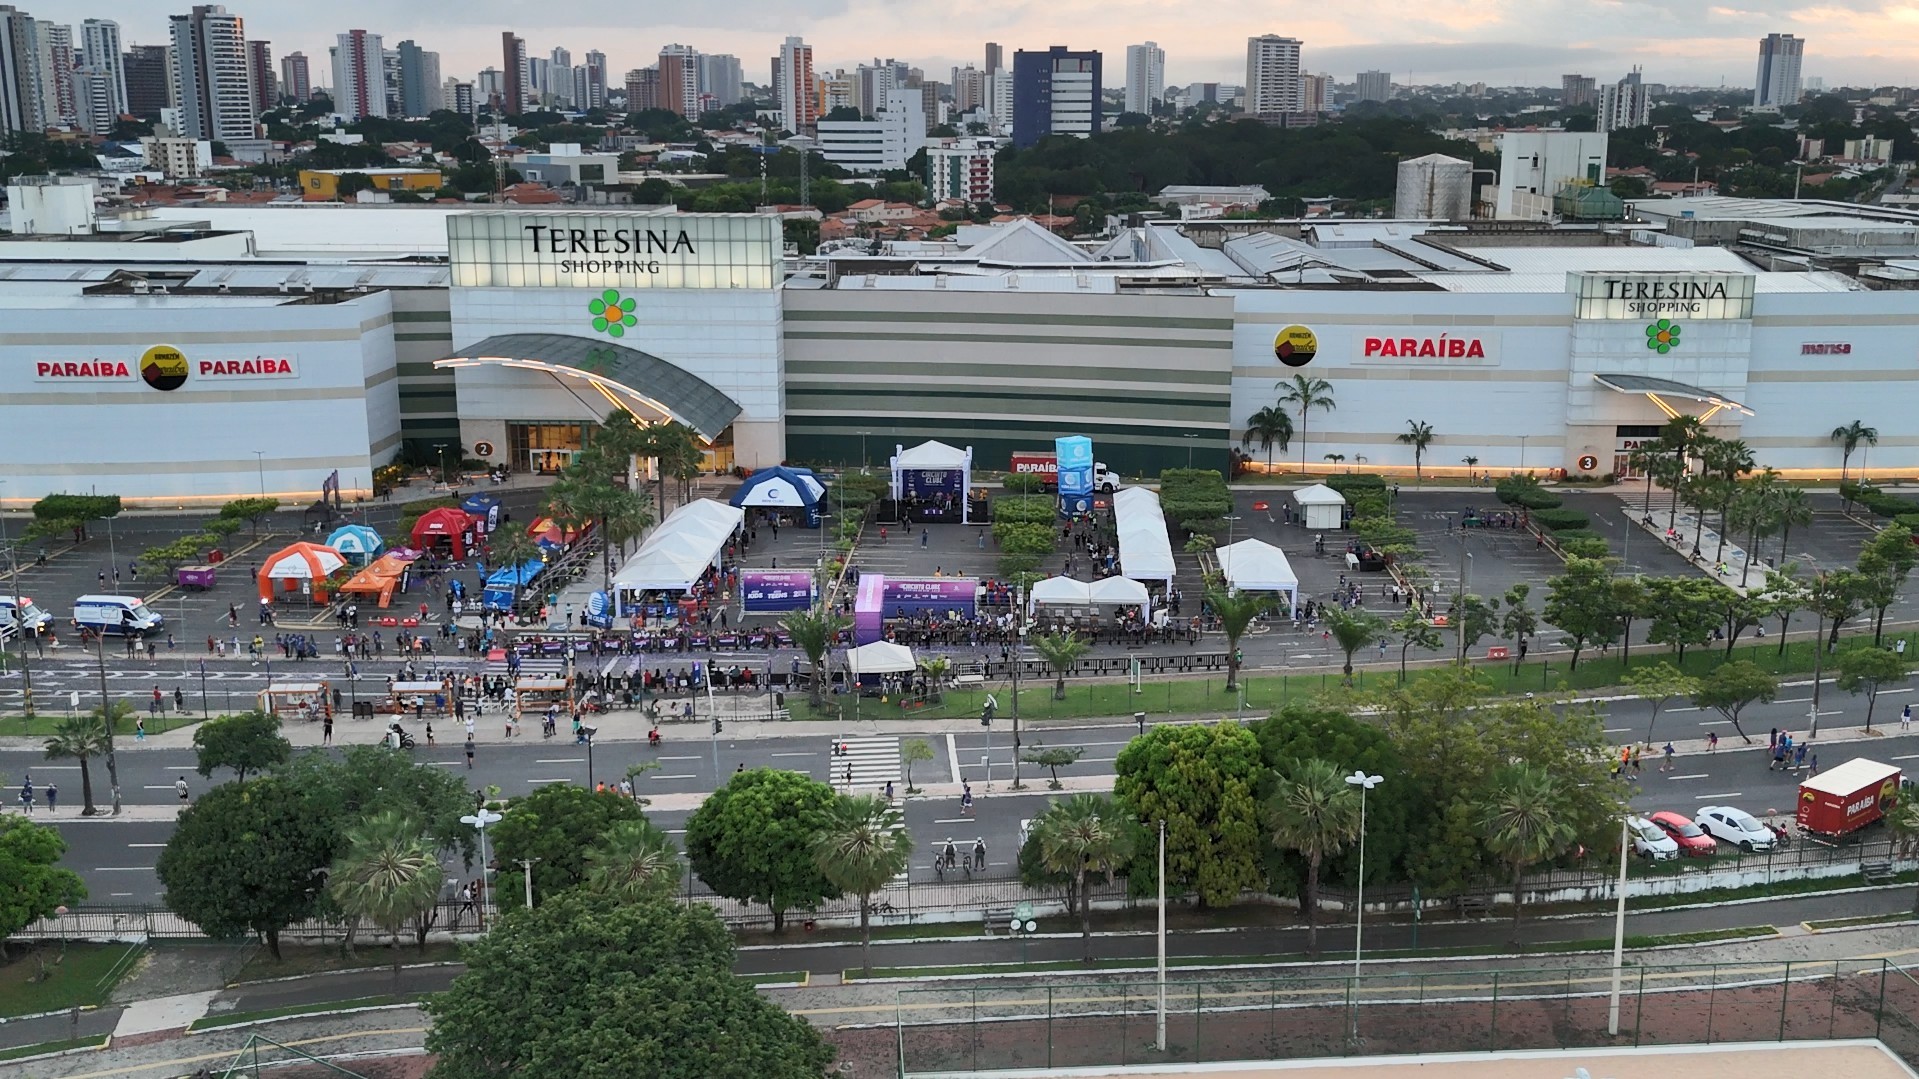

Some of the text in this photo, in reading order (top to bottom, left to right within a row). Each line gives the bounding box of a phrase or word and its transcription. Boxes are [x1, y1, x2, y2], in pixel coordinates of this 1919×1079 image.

[525, 225, 696, 254] TERESINA
[561, 259, 660, 274] SHOPPING
[1604, 280, 1727, 300] TERESINA
[1628, 302, 1701, 313] SHOPPING
[1364, 333, 1485, 358] PARAÍBA
[37, 358, 130, 377] PARAÍBA
[199, 355, 292, 375] PARAÍBA
[480, 444, 488, 455] 2
[1584, 458, 1592, 469] 3
[1846, 795, 1874, 817] PARAÍBA
